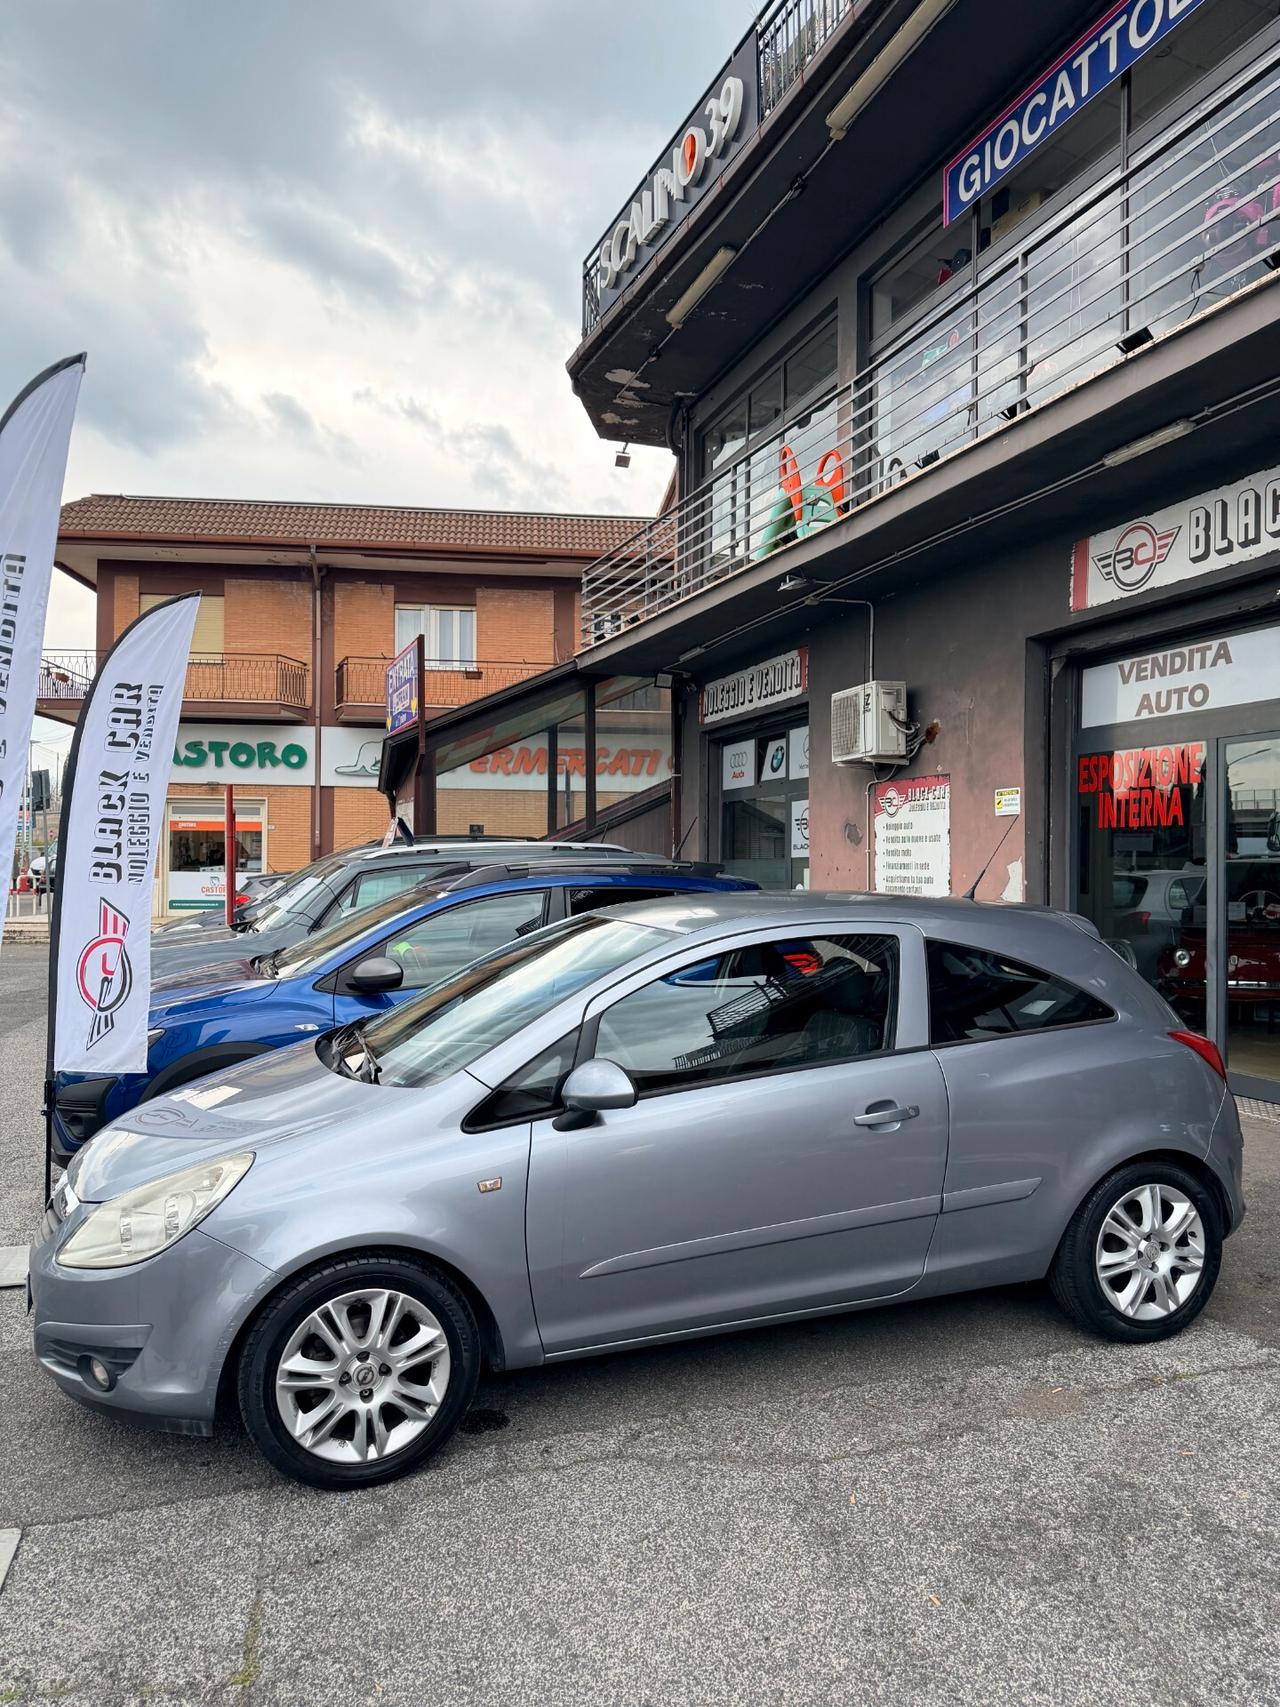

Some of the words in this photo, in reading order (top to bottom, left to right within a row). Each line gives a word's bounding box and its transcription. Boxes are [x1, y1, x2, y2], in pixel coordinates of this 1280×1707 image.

[704, 676, 745, 717] NOLEGGIO
[748, 672, 755, 703] E
[756, 655, 801, 700] VENDITA
[1118, 641, 1232, 685] VENDITA
[104, 682, 142, 754] CAR
[1135, 683, 1210, 717] AUTO
[131, 771, 149, 783] E
[731, 771, 745, 780] Audi
[1078, 743, 1204, 793] ESPOSIZIONE
[88, 770, 129, 884] BLACK
[1098, 787, 1184, 830] INTERNA
[127, 793, 149, 886] NOLEGGIO
